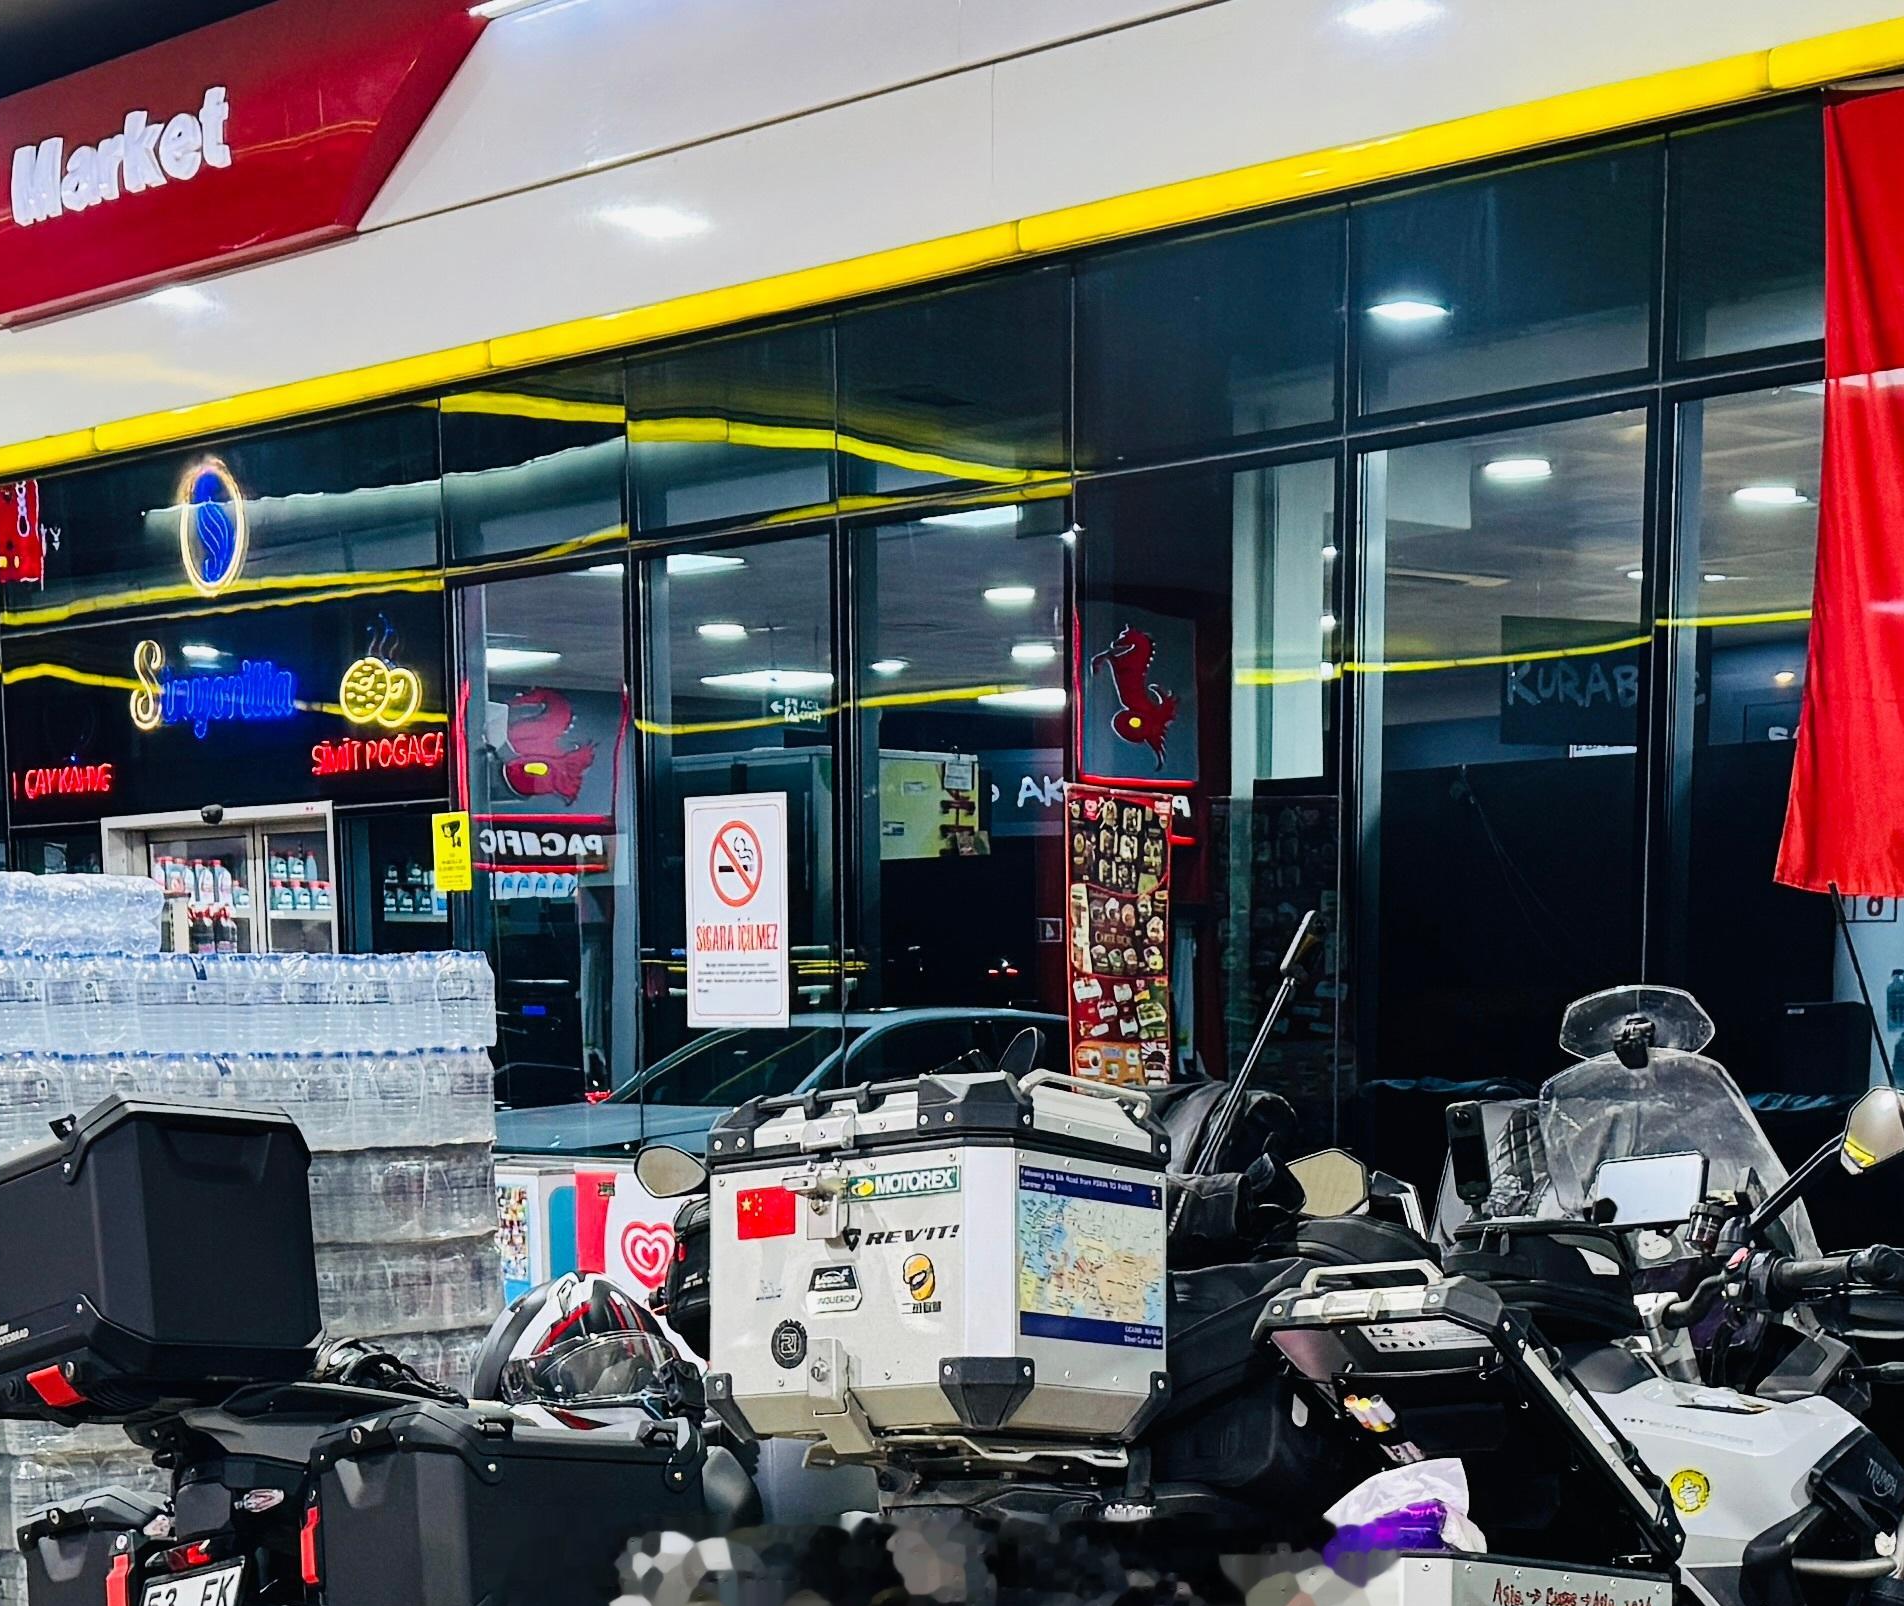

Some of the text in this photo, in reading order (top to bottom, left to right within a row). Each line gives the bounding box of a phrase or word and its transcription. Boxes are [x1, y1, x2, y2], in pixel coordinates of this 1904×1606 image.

[11, 86, 232, 227] Market
[696, 917, 778, 954] SİGARA İÇİLMEZ
[875, 1167, 955, 1194] MOTOREX
[865, 1224, 960, 1246] REV'IT!
